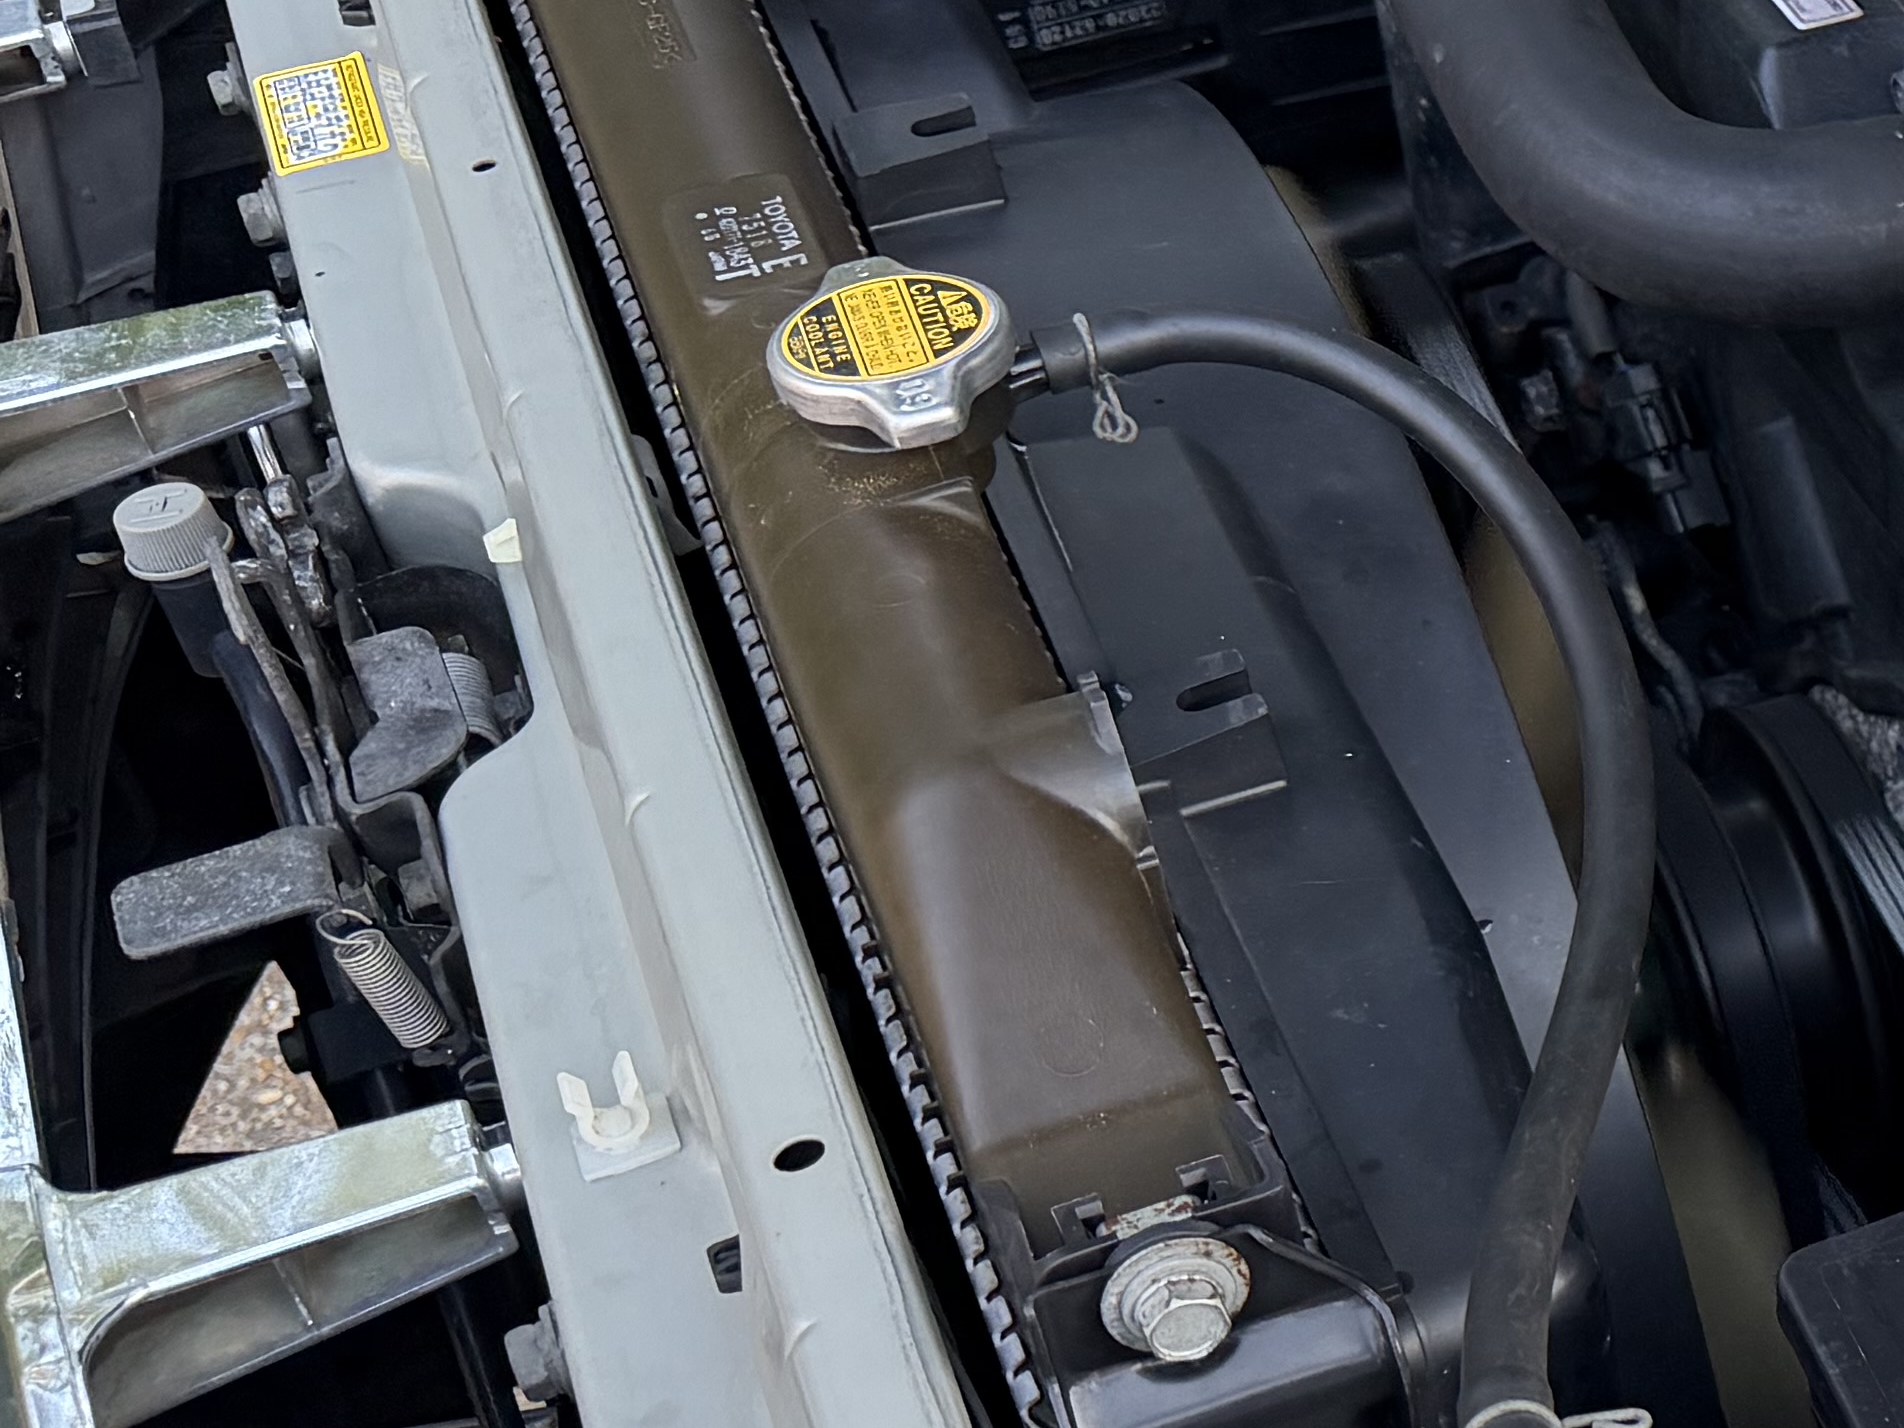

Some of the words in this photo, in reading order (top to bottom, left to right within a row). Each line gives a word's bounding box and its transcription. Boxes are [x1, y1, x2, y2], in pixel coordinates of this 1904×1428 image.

[760, 192, 801, 252] TOYOTA
[715, 264, 762, 281] T
[761, 253, 809, 274] E
[803, 315, 835, 369] COOLANT
[821, 314, 852, 362] ENGINE
[909, 283, 954, 350] CAUTION
